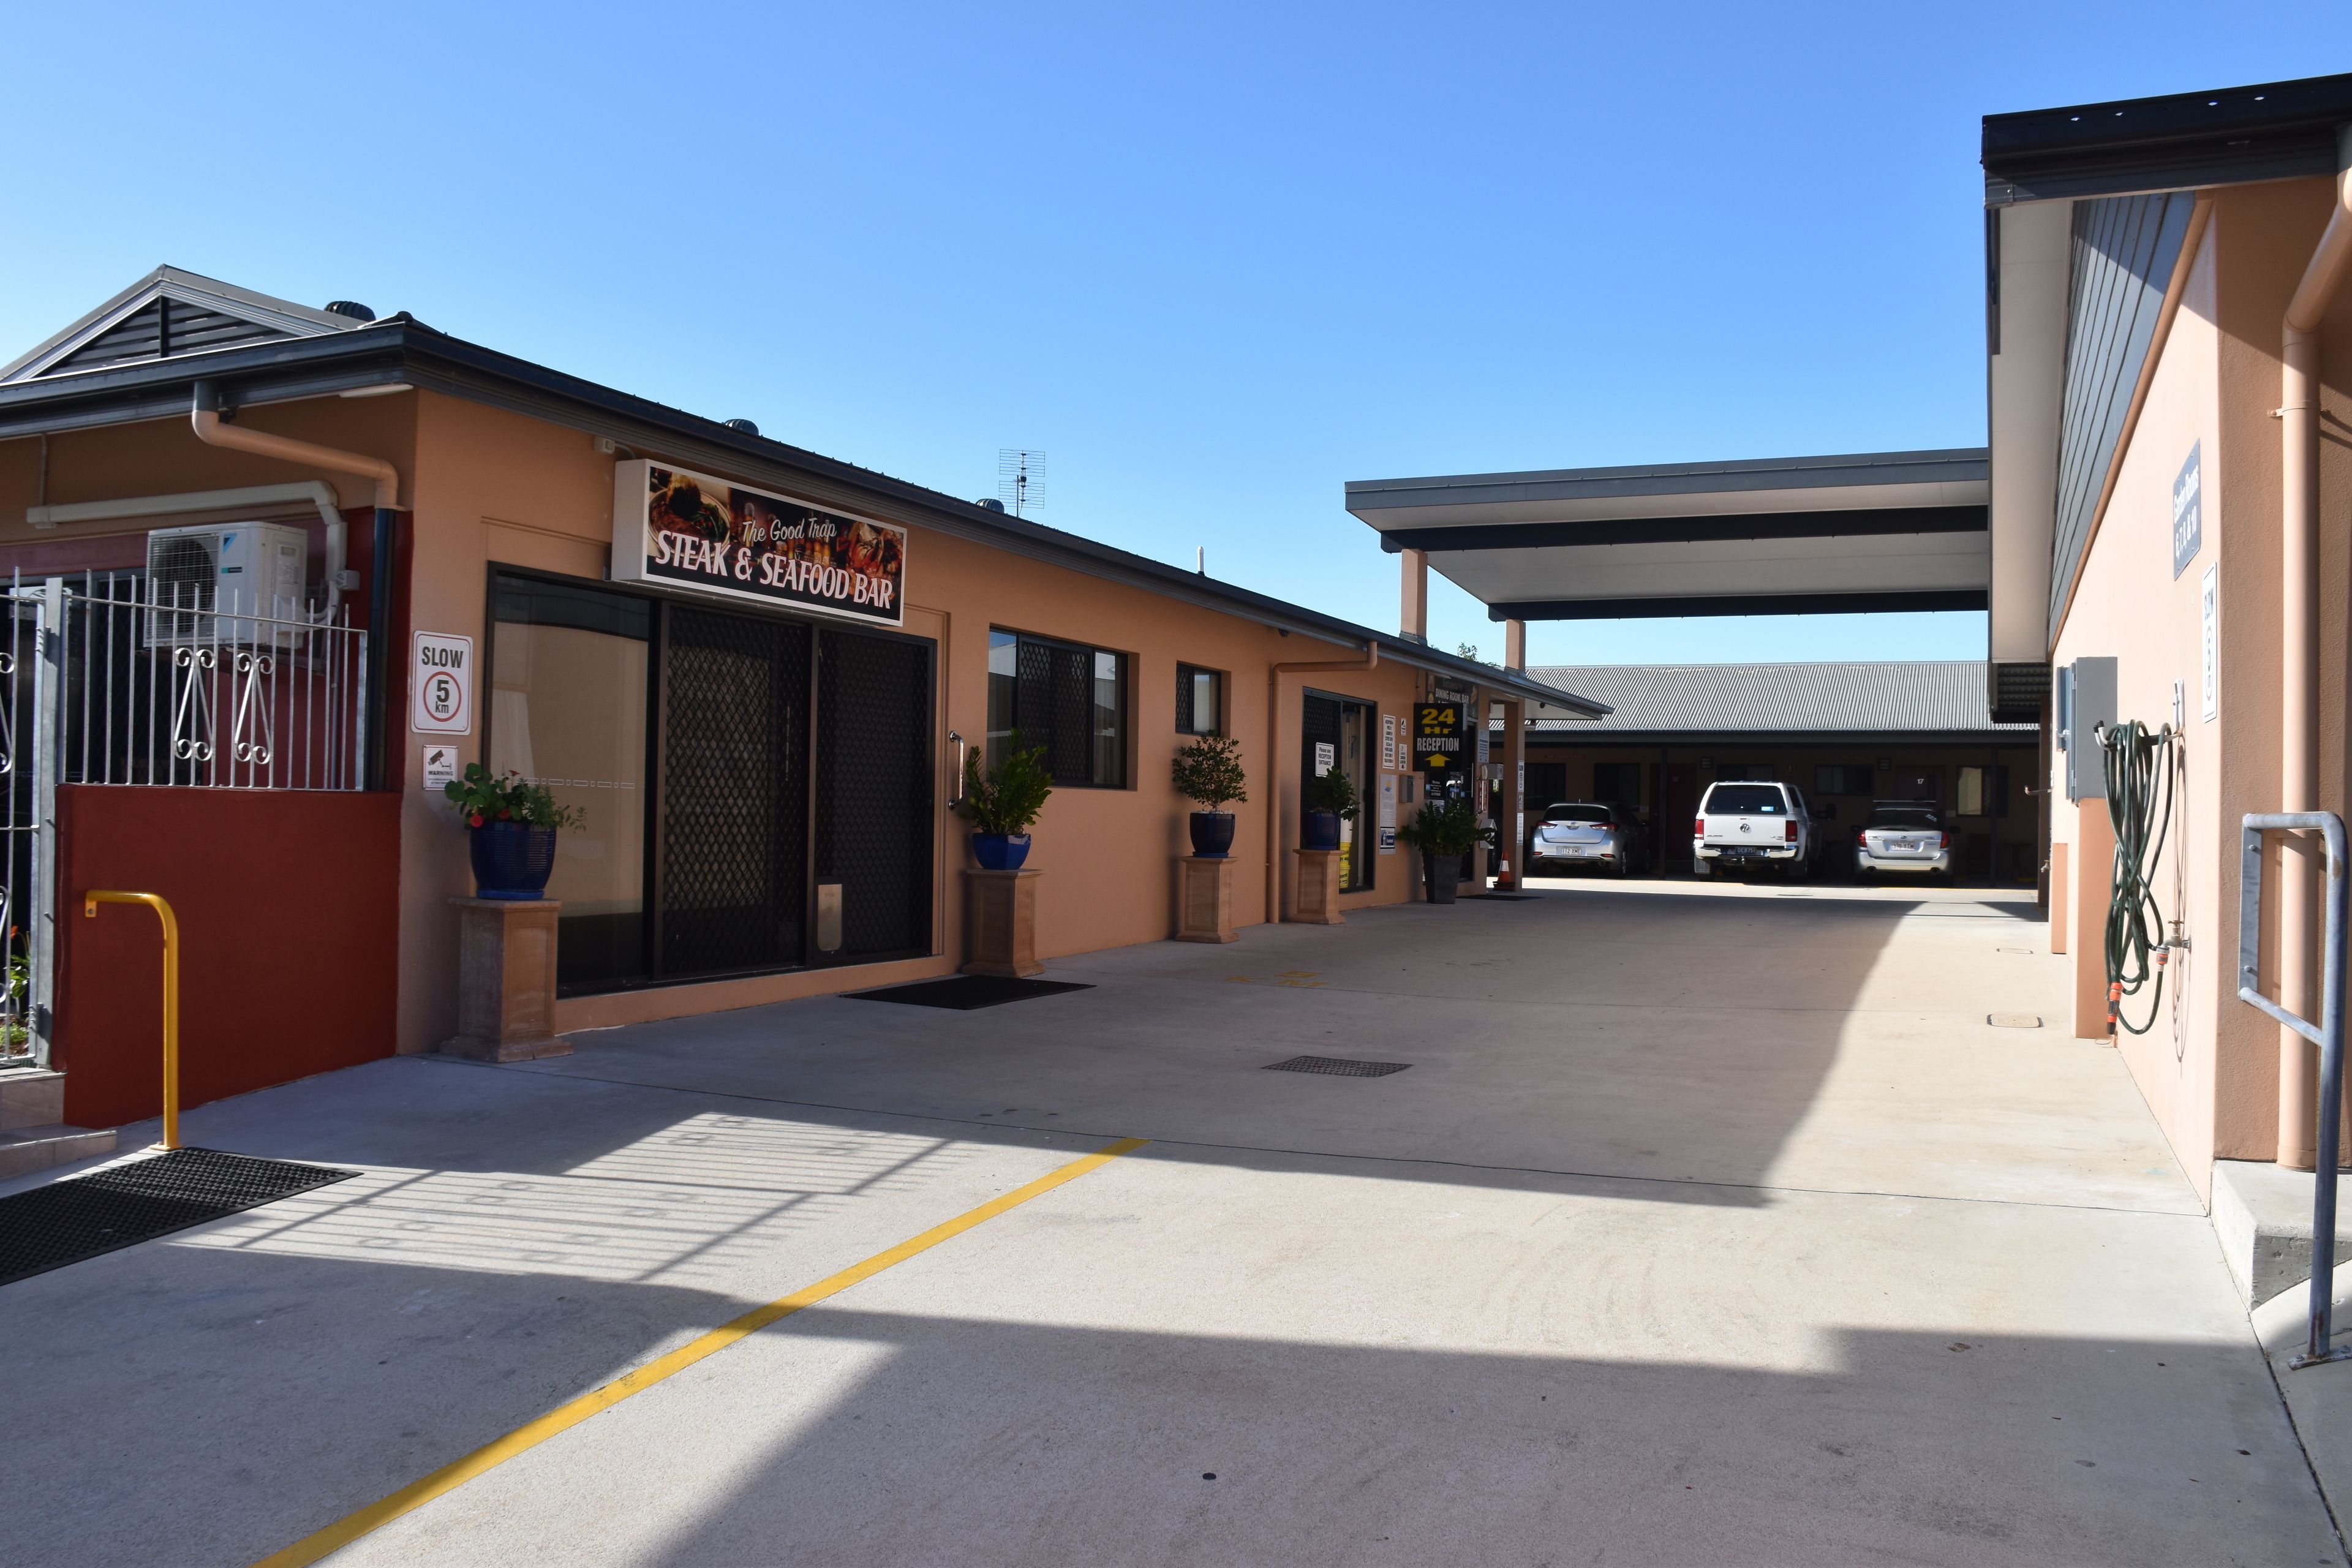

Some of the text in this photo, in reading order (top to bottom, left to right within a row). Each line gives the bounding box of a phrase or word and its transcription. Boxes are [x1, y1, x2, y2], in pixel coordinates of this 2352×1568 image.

[742, 517, 837, 542] The Good Trap
[655, 530, 893, 609] STEAK & SEAFOOD BAR
[421, 646, 464, 669] SLOW
[436, 679, 450, 703] 5
[1435, 688, 1449, 699] DINING
[435, 701, 449, 714] km
[1421, 708, 1456, 725] 24
[1417, 737, 1460, 752] RECEPTION
